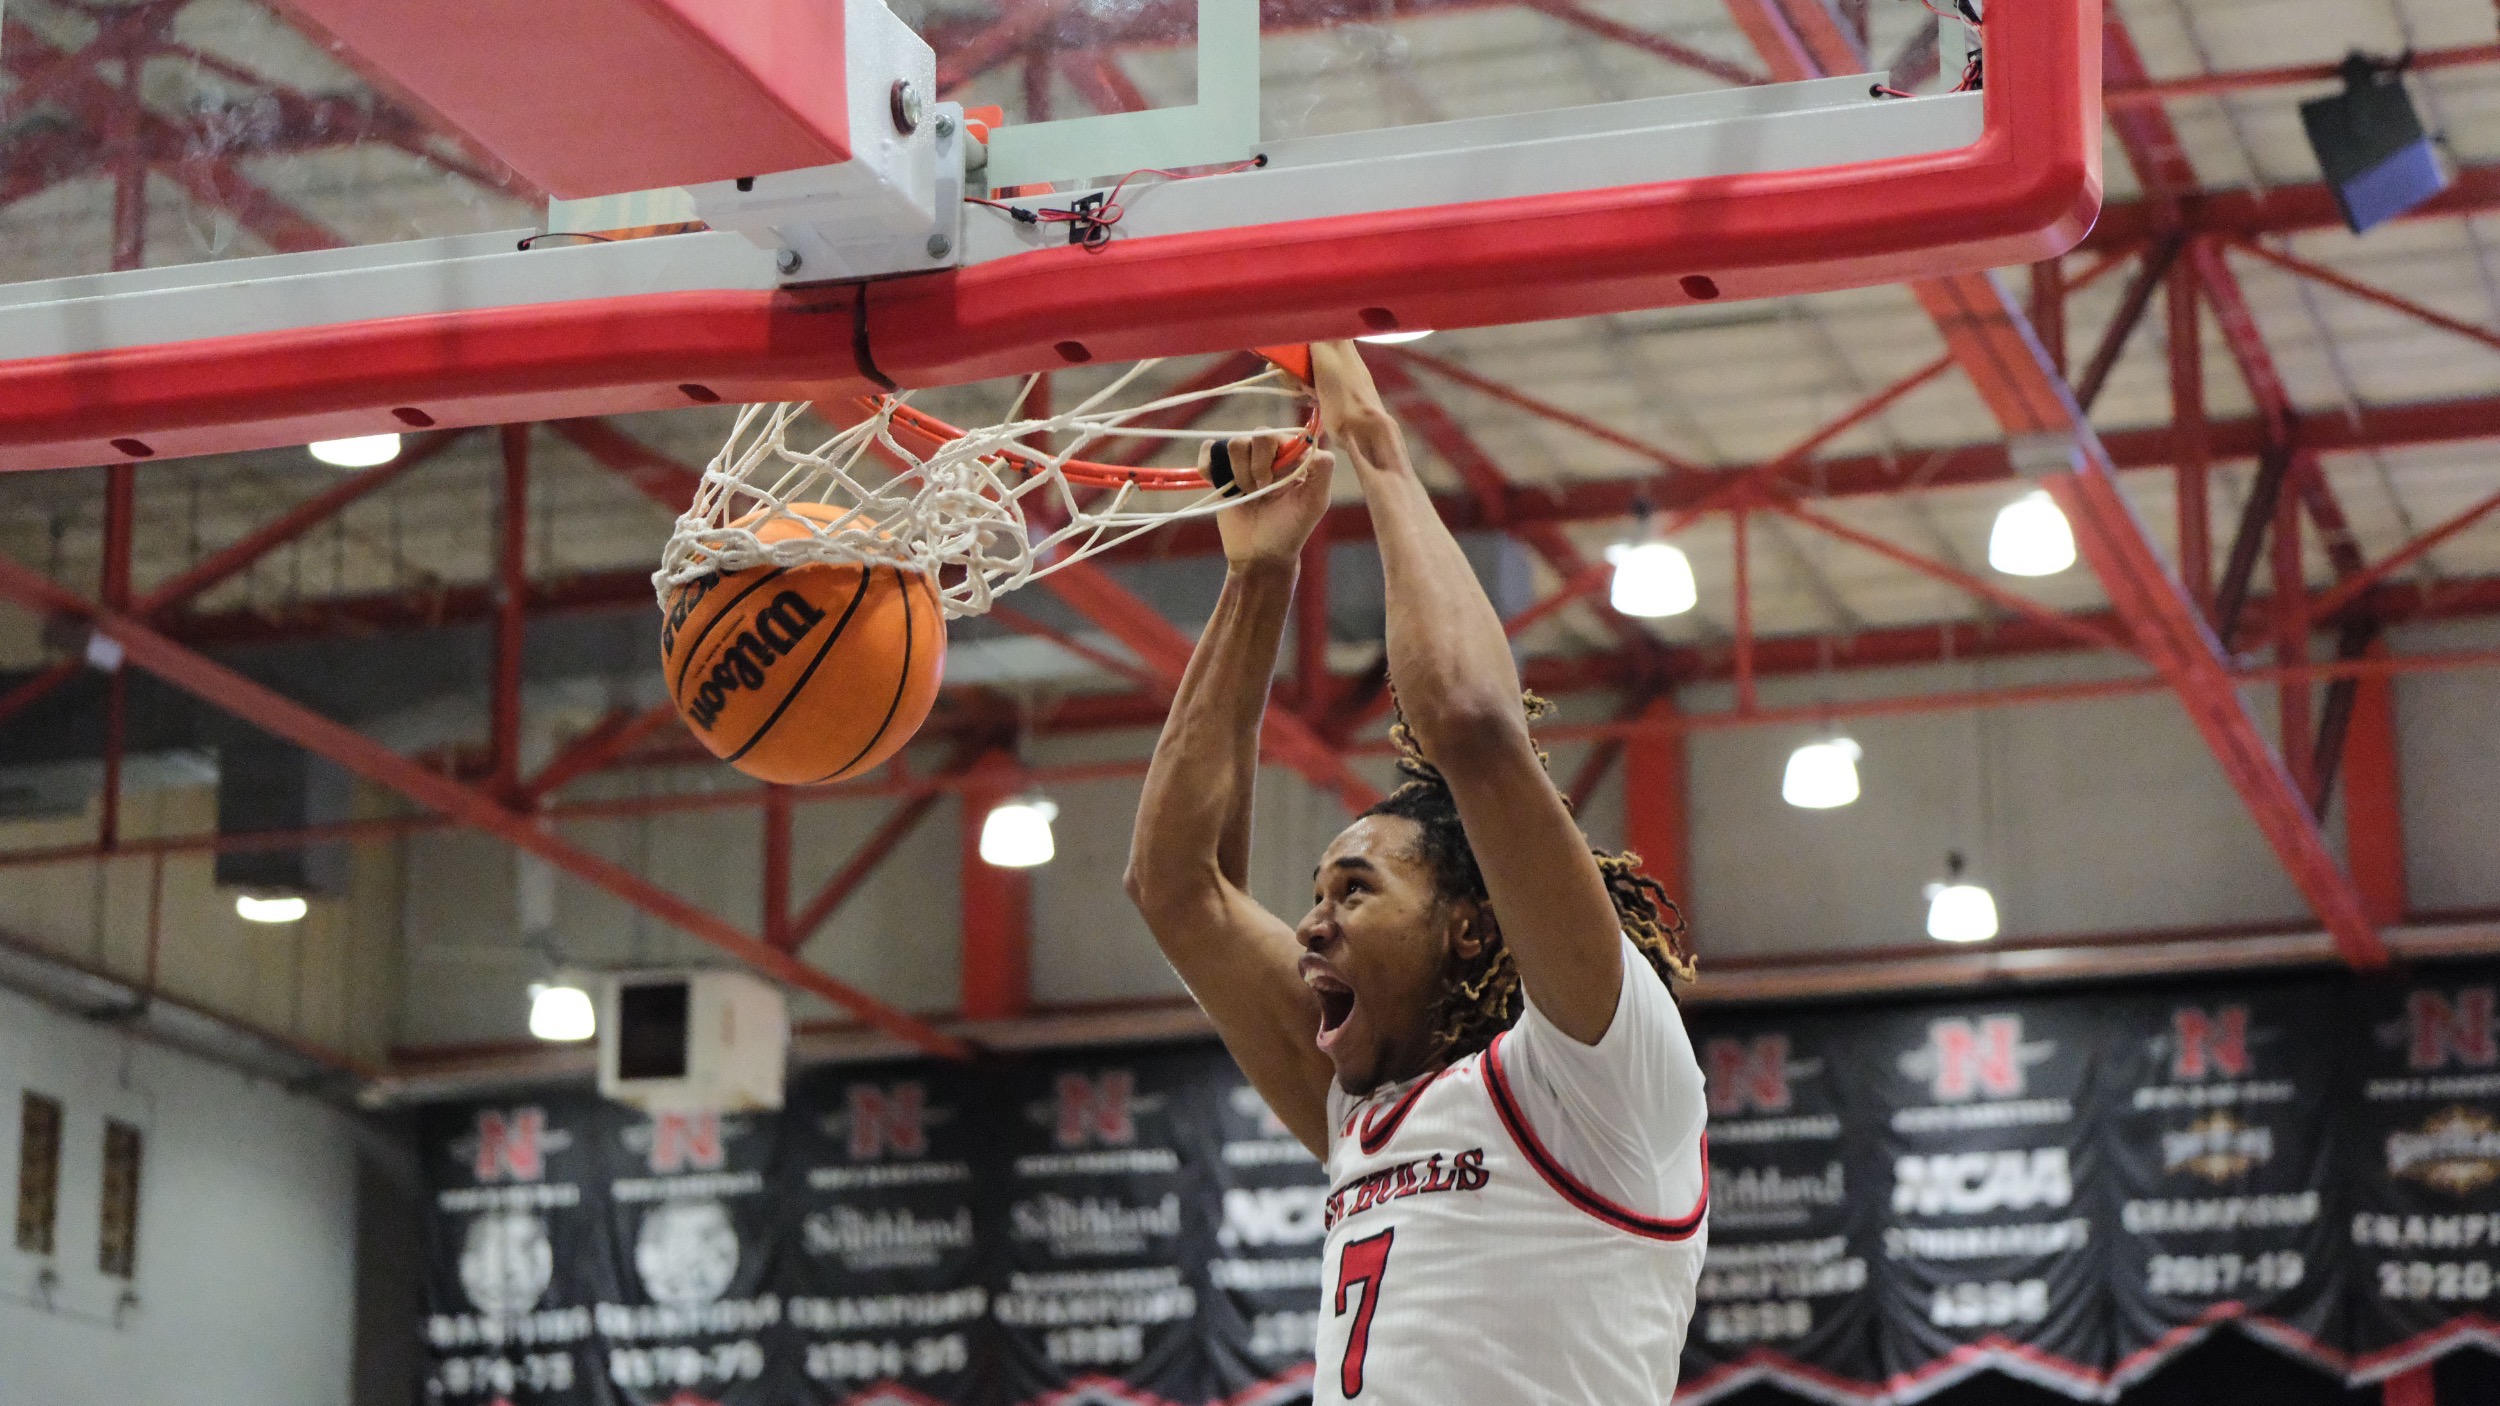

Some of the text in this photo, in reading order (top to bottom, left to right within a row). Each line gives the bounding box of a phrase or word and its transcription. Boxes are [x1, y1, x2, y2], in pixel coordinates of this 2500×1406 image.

[688, 591, 827, 732] Wilson
[1709, 1040, 1792, 1114] N
[1929, 1014, 2035, 1098] N
[2174, 1007, 2253, 1076] N
[475, 1110, 543, 1179] N
[848, 1080, 926, 1156] N
[1058, 1073, 1136, 1145] N
[1894, 1150, 2071, 1215] NCAA
[1335, 1226, 1395, 1400] 7
